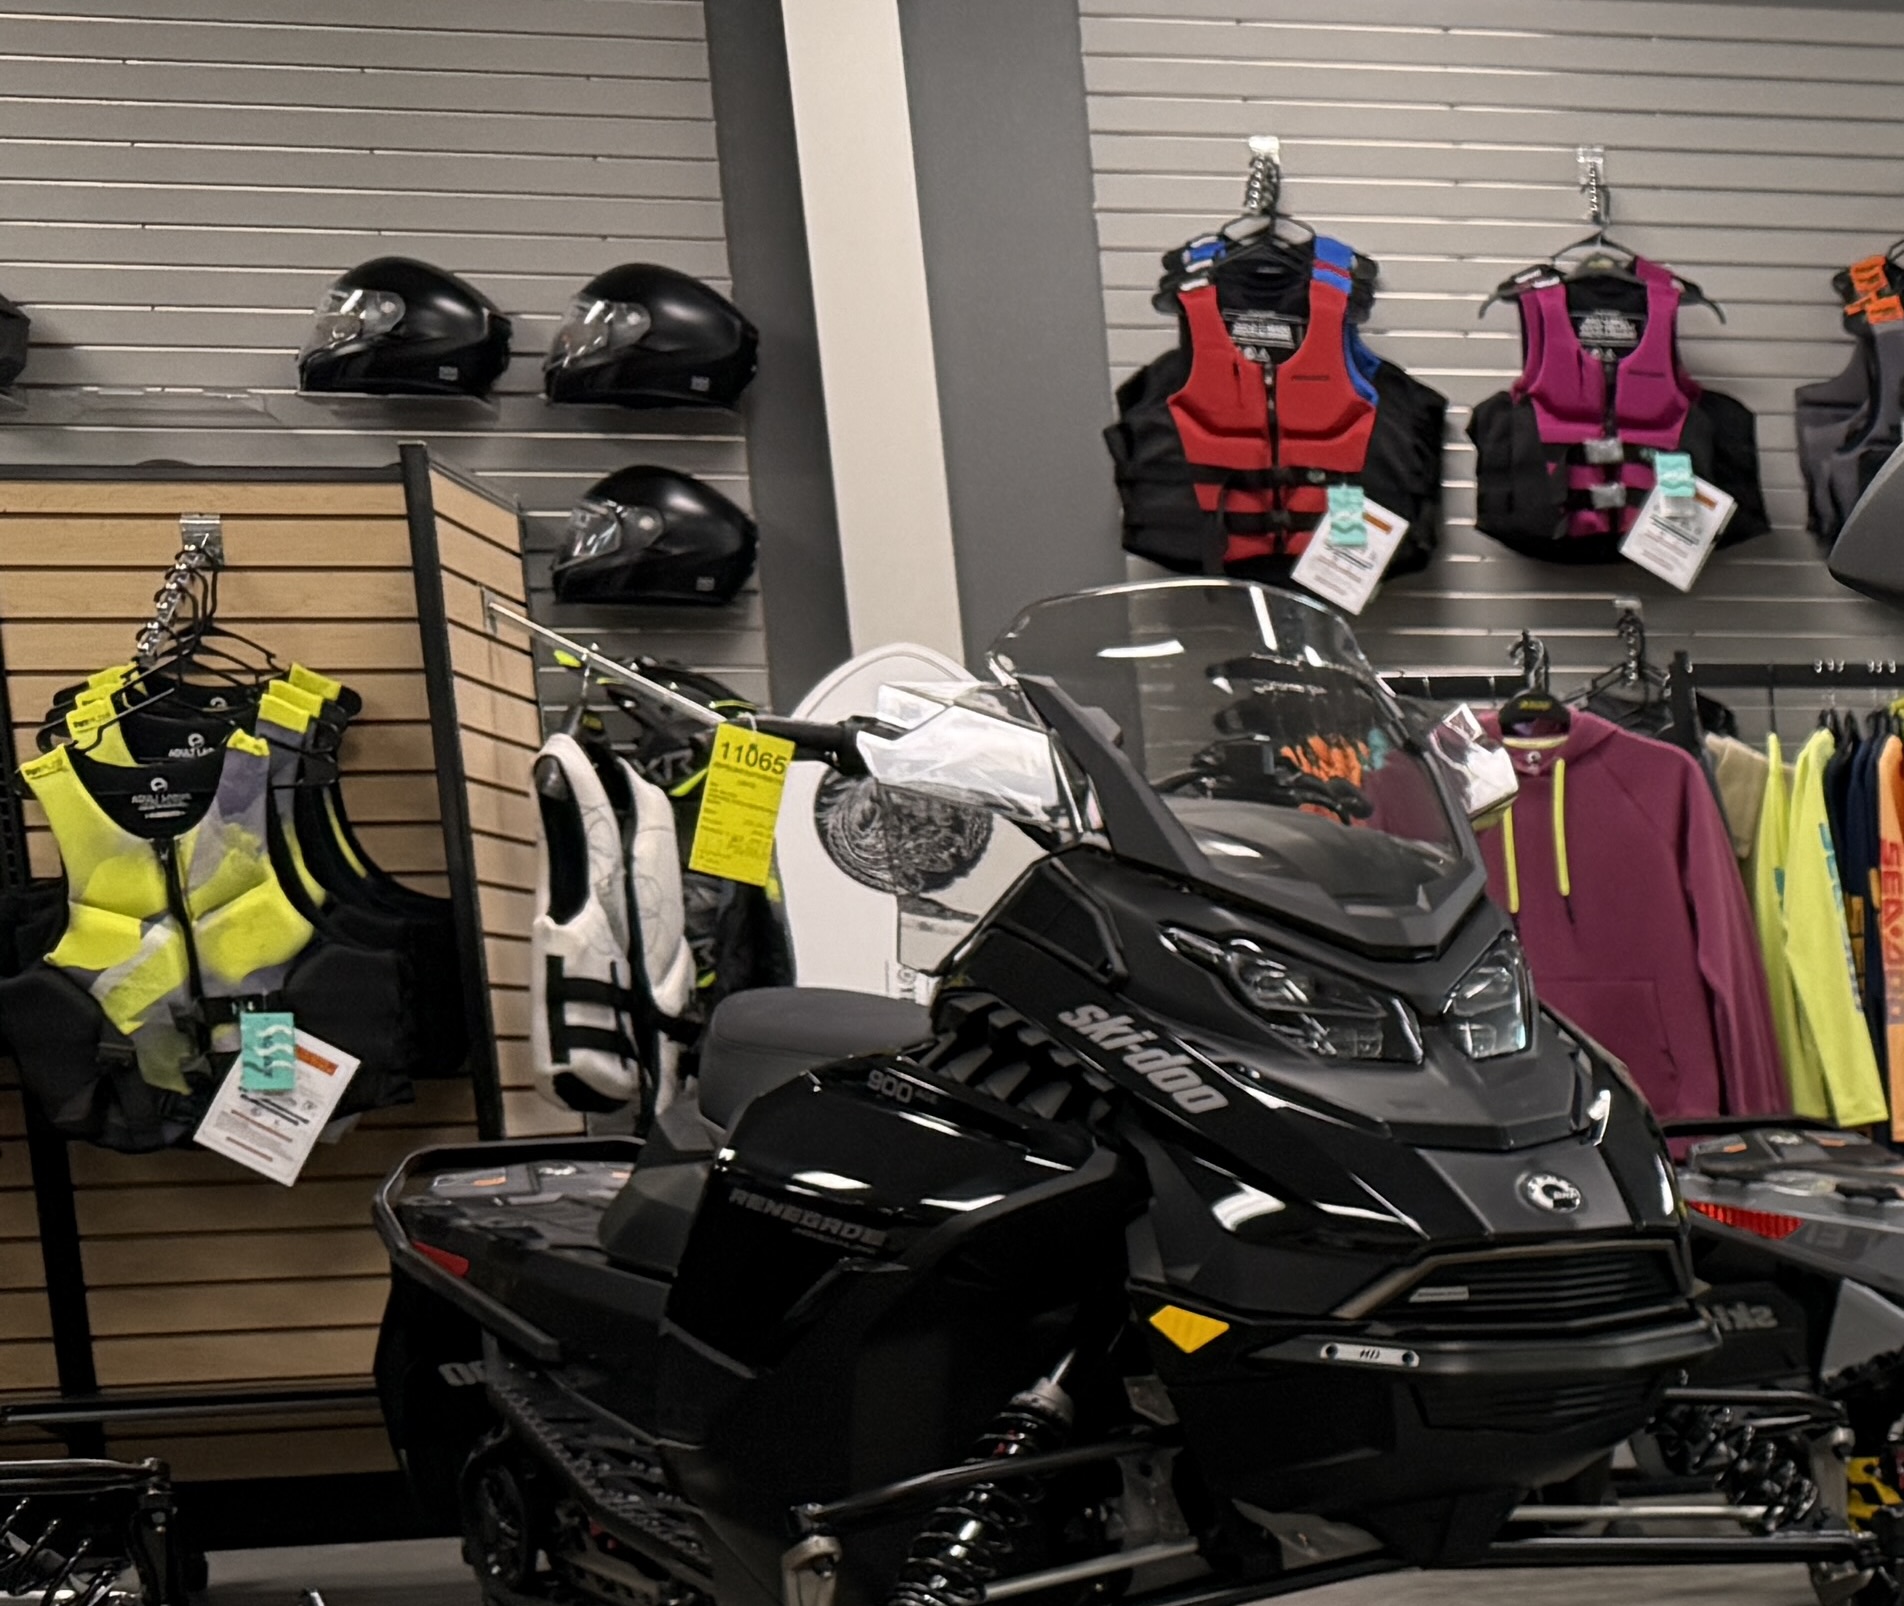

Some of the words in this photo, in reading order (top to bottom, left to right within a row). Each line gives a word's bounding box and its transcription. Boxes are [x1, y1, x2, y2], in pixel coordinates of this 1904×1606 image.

[719, 739, 788, 777] 11065
[1056, 1001, 1229, 1115] ski-doo
[867, 1068, 914, 1105] 900
